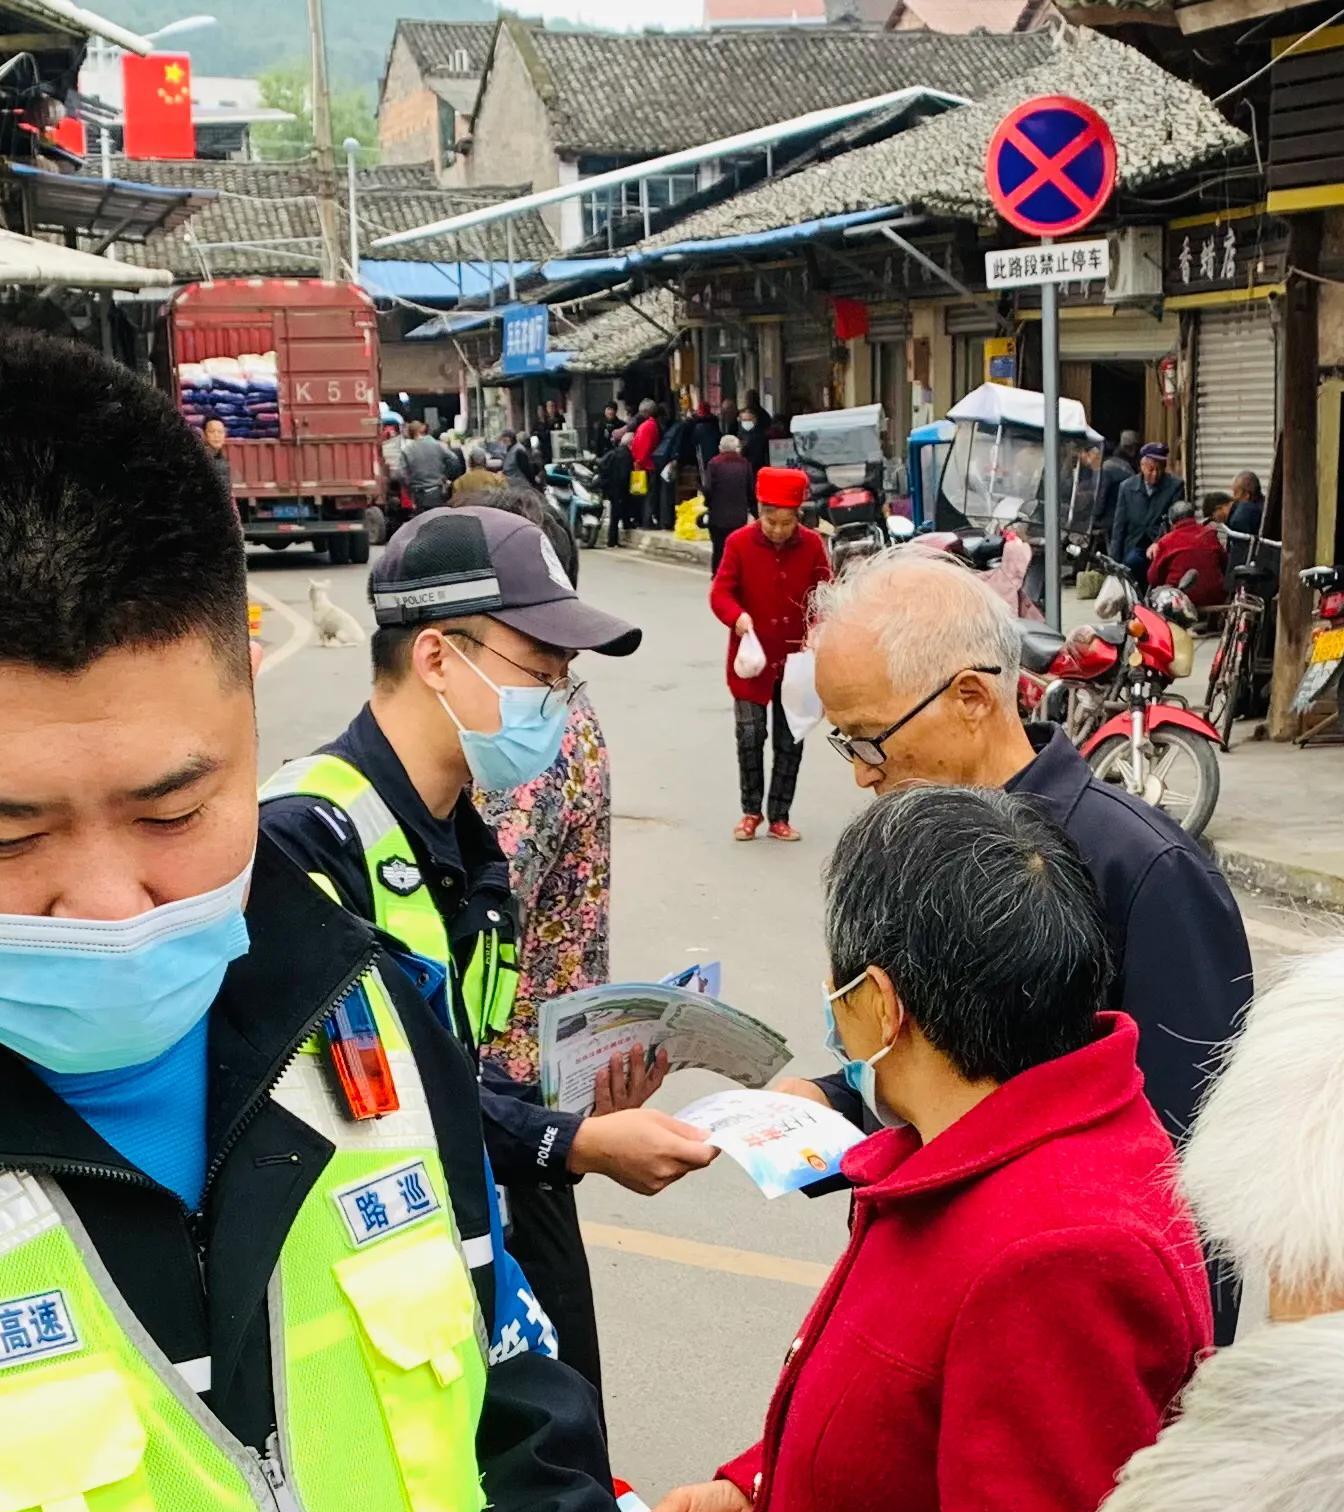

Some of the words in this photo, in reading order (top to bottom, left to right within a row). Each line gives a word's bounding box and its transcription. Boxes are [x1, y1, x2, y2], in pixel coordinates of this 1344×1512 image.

[992, 248, 1103, 280] 此路段禁止停车
[536, 1125, 559, 1167] POLICE
[356, 1169, 431, 1233] 路巡
